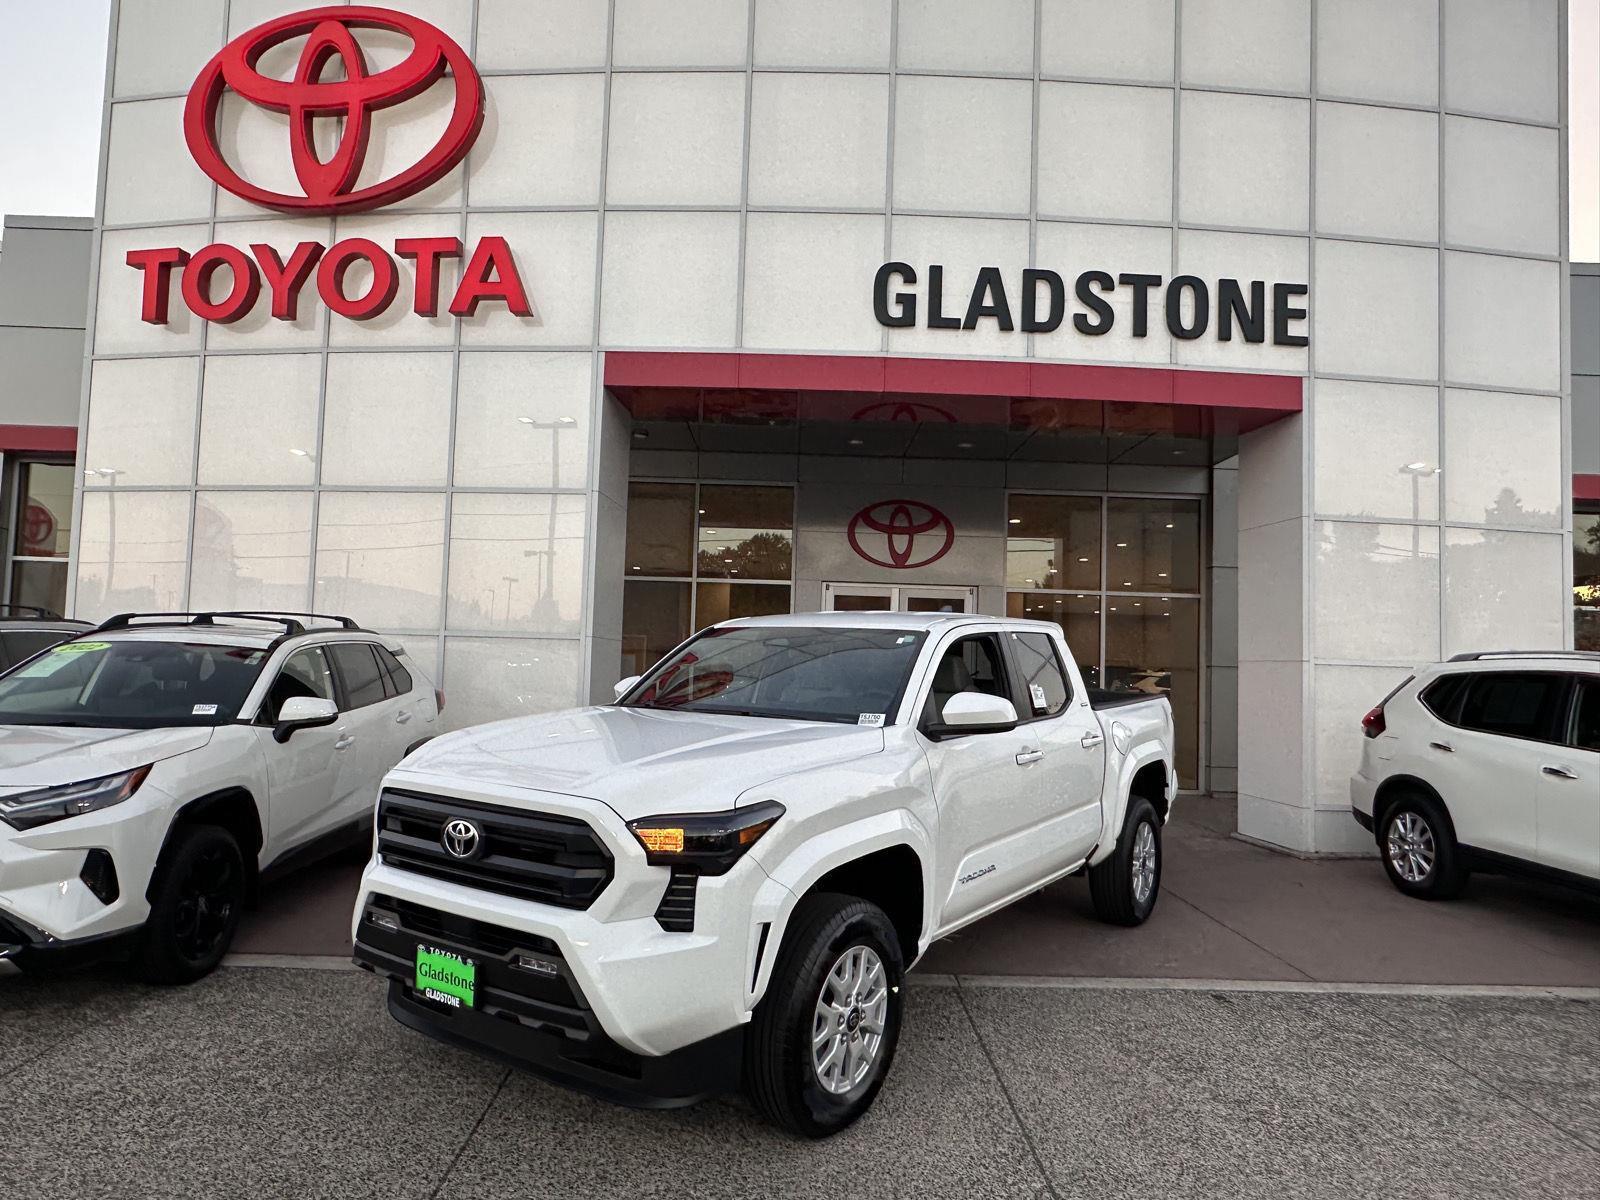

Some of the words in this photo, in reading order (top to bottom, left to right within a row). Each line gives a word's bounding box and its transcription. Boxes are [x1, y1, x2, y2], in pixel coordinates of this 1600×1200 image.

[126, 236, 534, 325] TOYOTA
[873, 261, 1309, 346] GLADSTONE
[429, 947, 463, 963] TOYOTA
[419, 962, 475, 991] Gladstone
[425, 987, 460, 1008] GLADSTONE
